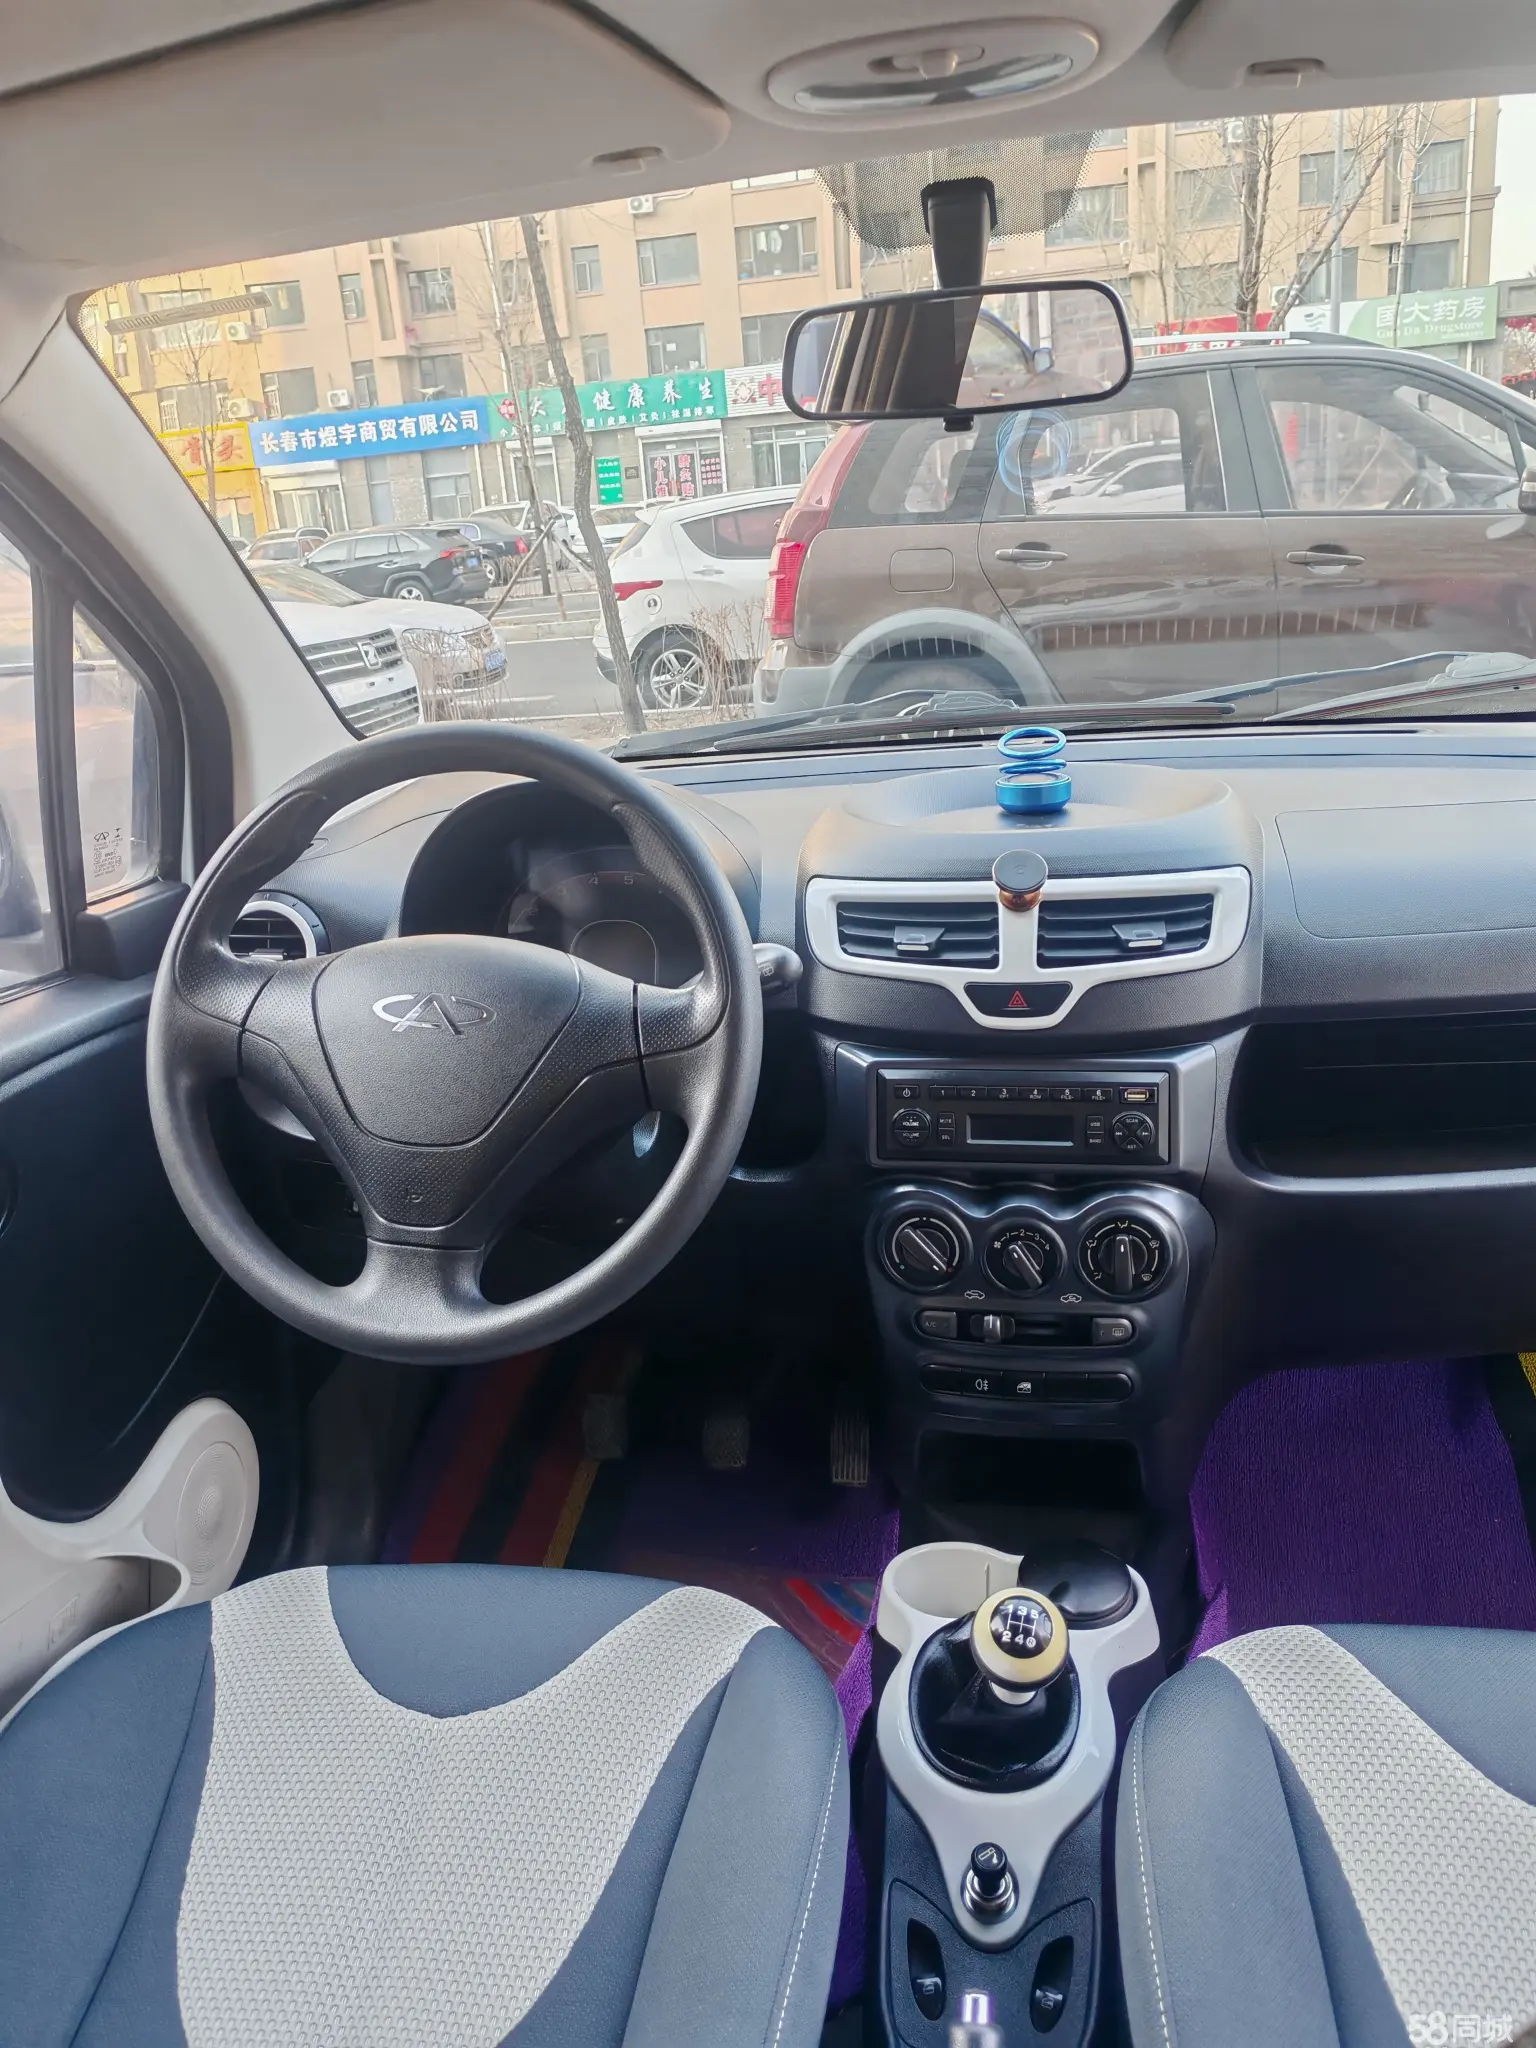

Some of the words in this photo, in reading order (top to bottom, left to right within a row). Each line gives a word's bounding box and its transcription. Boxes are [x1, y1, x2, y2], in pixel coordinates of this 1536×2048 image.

[1376, 297, 1486, 328] 国大药房
[1404, 325, 1421, 336] Da
[1425, 321, 1484, 334] Drugstore
[259, 409, 479, 455] 长春市煜宇商贸有限公司
[588, 875, 599, 886] 4
[624, 875, 634, 886] 5
[970, 1089, 976, 1097] 2
[1019, 1228, 1025, 1237] 2
[1034, 1232, 1040, 1241] 3
[1044, 1243, 1050, 1251] 4
[925, 1320, 937, 1328] A/C
[1006, 1603, 1014, 1614] 1
[1017, 1605, 1028, 1616] 3
[1030, 1608, 1039, 1620] 5
[1002, 1630, 1012, 1642] 2
[1014, 1633, 1024, 1645] 4
